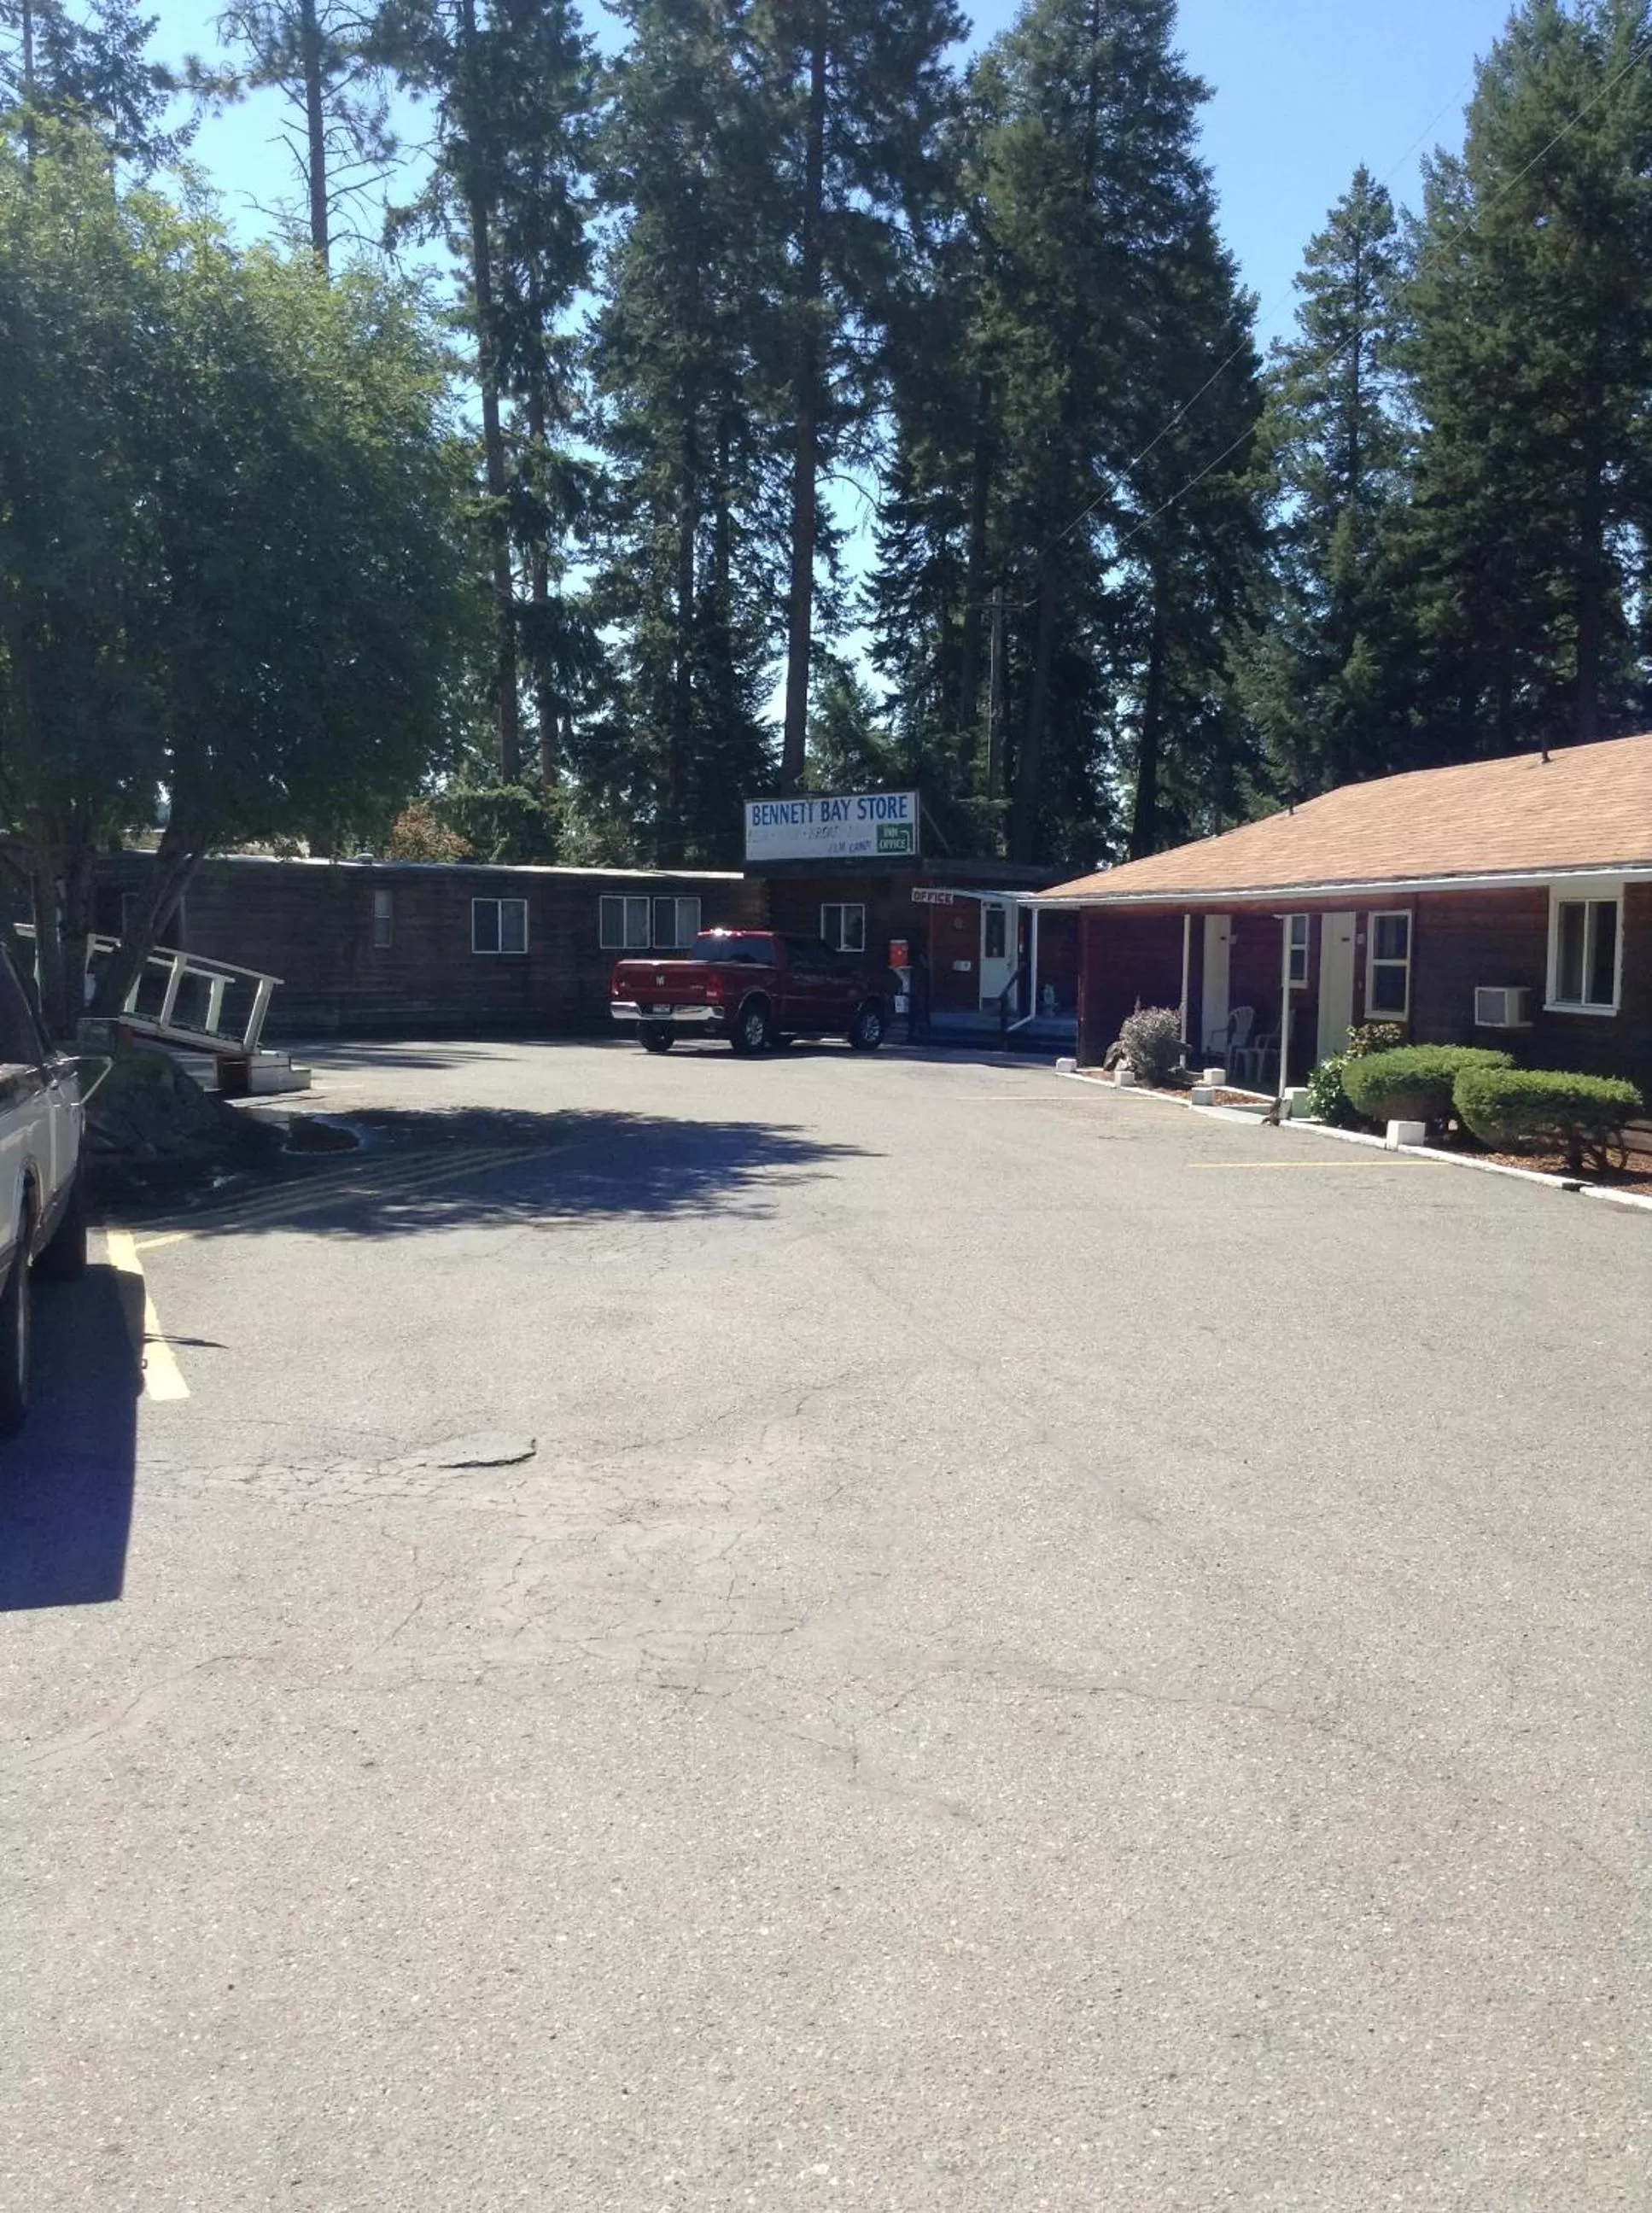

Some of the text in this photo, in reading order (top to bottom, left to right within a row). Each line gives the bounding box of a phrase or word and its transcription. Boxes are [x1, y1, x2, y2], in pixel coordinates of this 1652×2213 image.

[752, 795, 908, 826] BENNETT BAY STORE
[883, 826, 899, 838] INN
[879, 838, 907, 850] OFFICE
[914, 890, 953, 904] OFFICE
